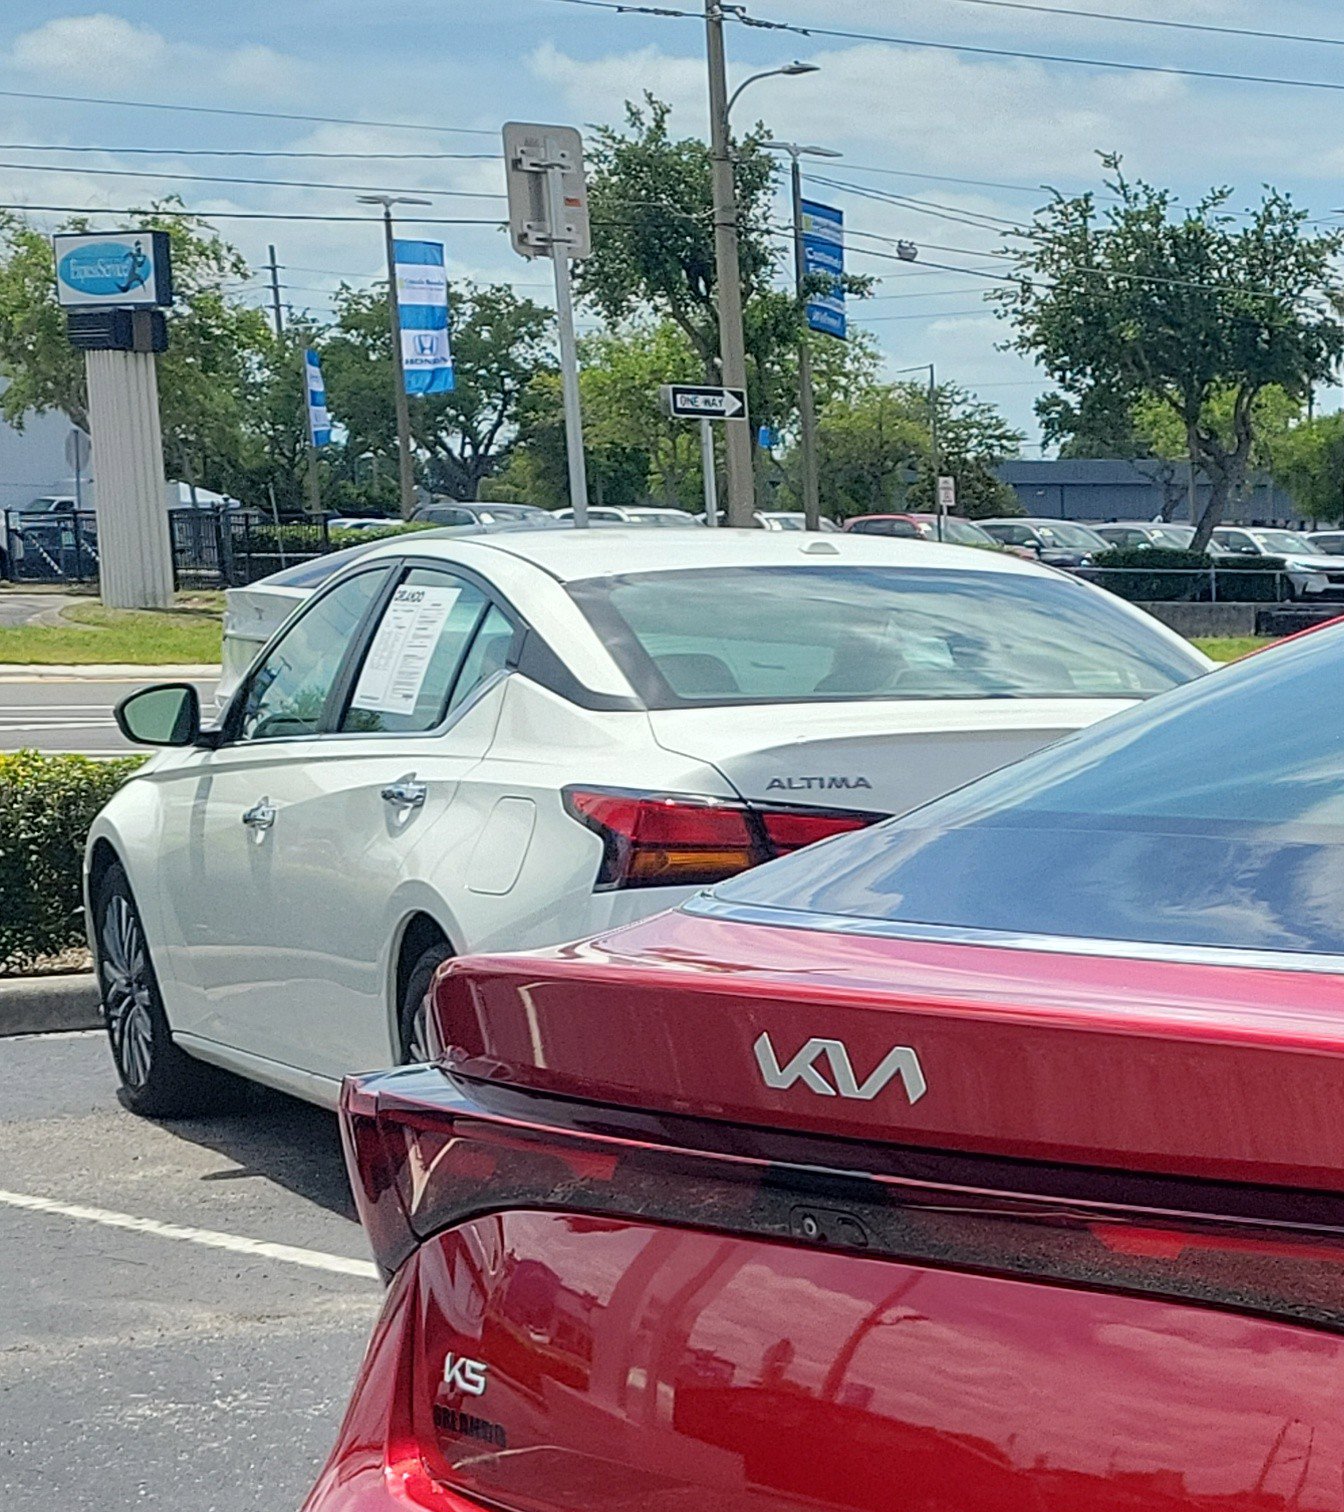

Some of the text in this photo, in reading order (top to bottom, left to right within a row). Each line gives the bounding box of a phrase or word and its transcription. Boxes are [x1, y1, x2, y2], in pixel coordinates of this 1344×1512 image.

[404, 357, 449, 366] HONDA
[680, 395, 723, 408] ONE WAY
[766, 776, 873, 791] ALTIMA
[753, 1031, 927, 1105] KIA
[443, 1351, 488, 1396] K5
